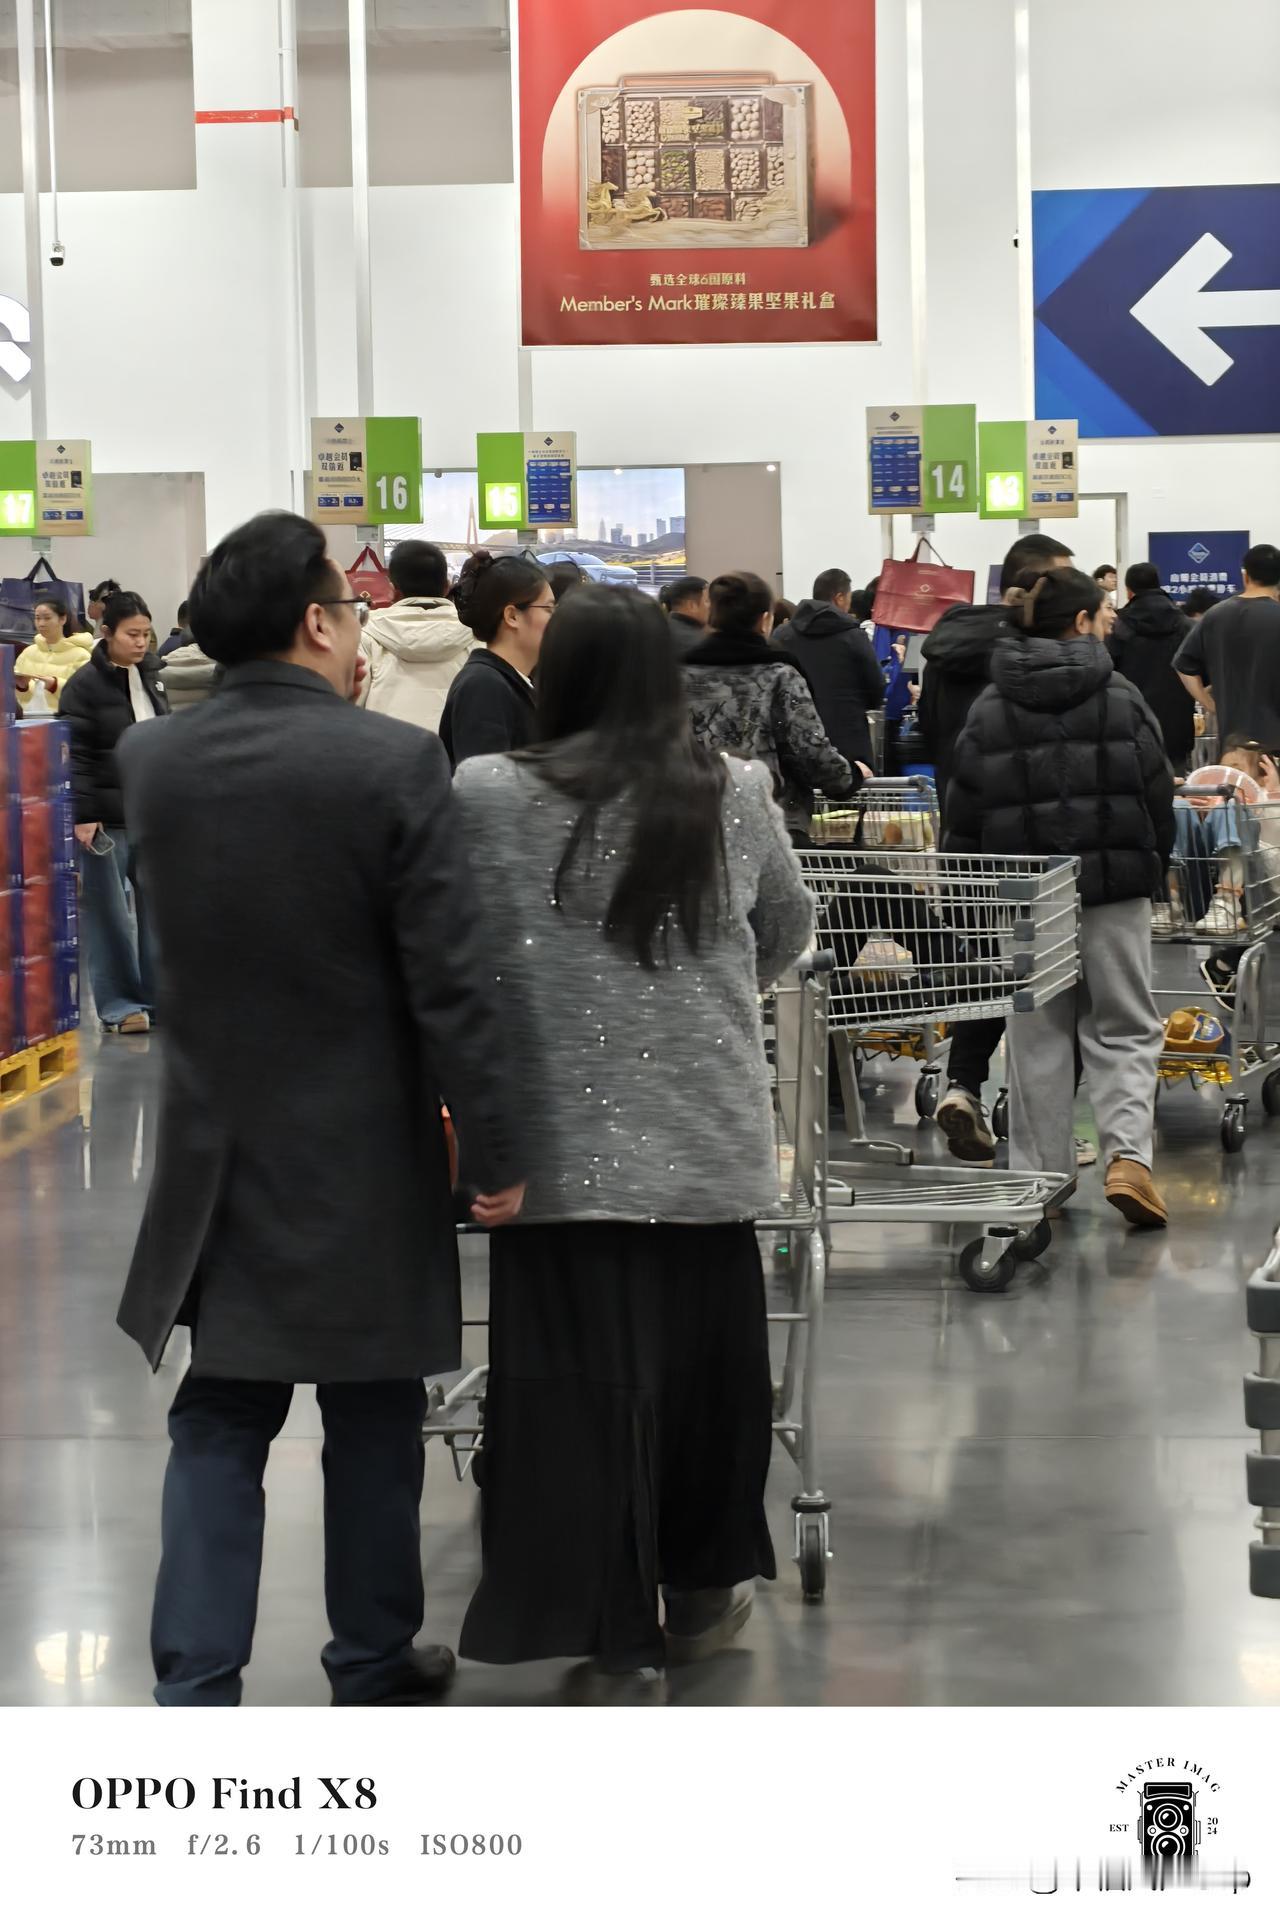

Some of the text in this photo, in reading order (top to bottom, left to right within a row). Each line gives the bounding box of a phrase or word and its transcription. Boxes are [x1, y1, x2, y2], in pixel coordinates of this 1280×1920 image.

[649, 272, 747, 286] 甄选全球6国原料
[560, 291, 836, 313] Member's Mark璀璨臻果坚果礼盒
[375, 475, 408, 510] 16
[931, 464, 966, 499] 14
[988, 474, 1020, 507] 13
[3, 493, 33, 525] 17
[488, 485, 519, 518] 15
